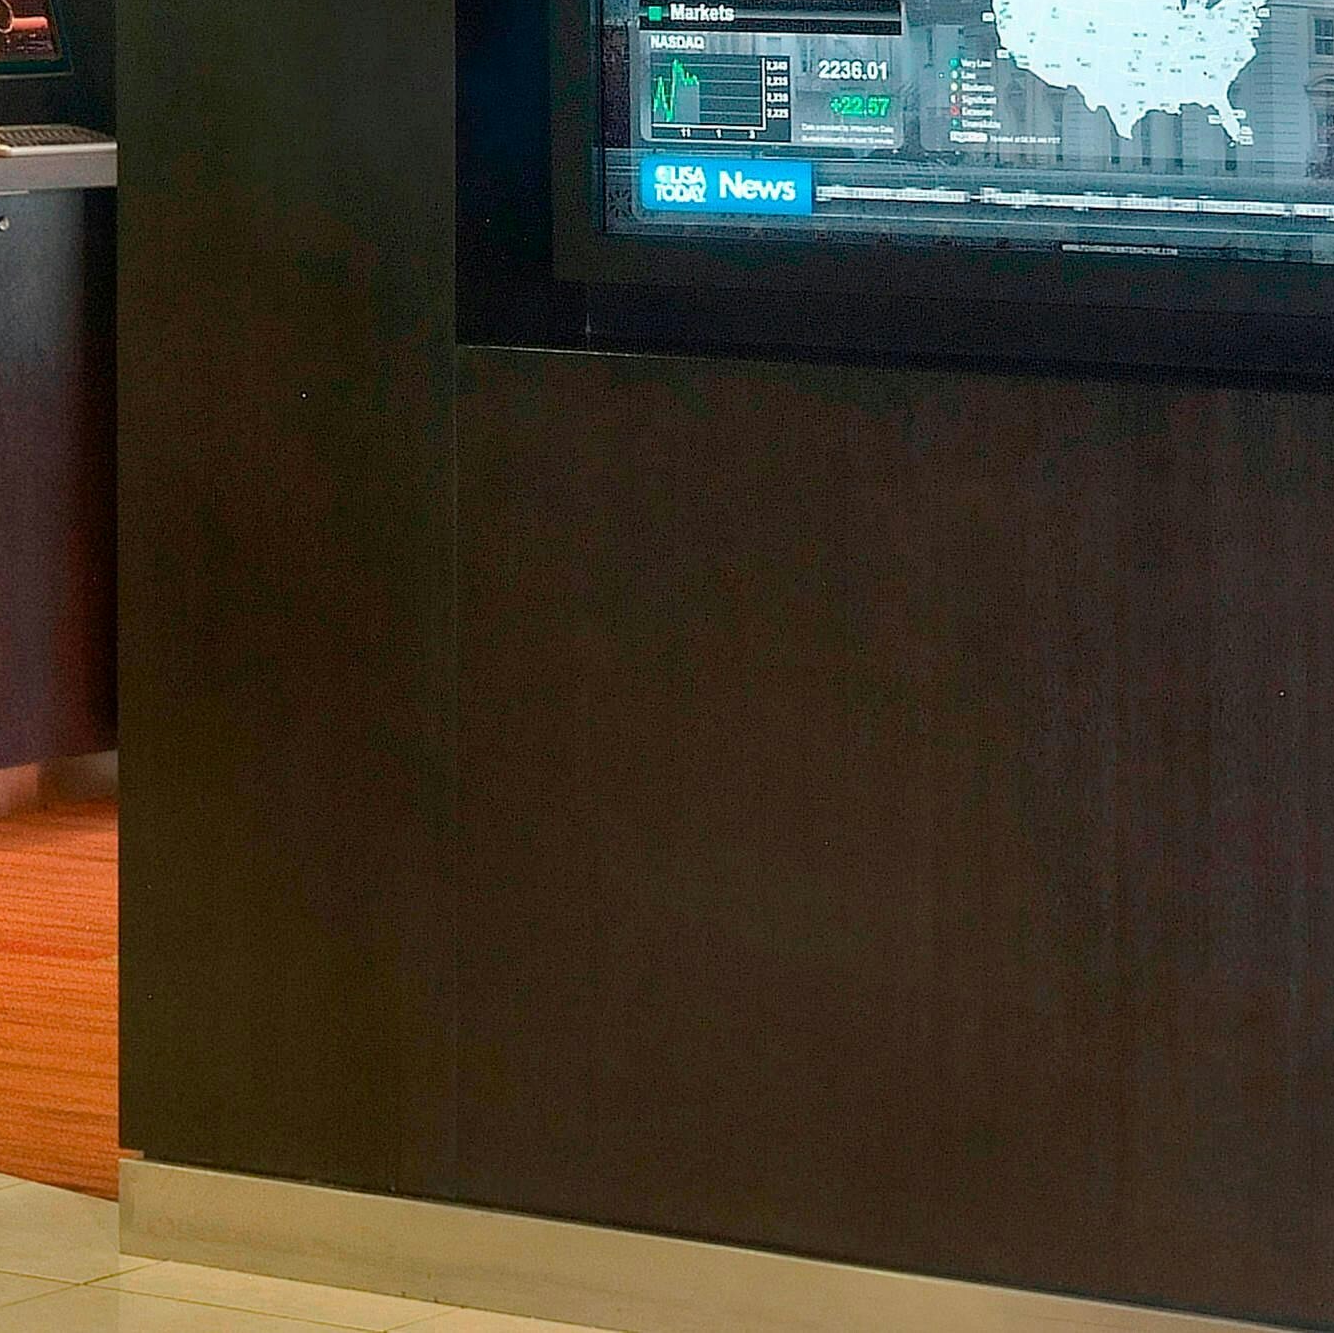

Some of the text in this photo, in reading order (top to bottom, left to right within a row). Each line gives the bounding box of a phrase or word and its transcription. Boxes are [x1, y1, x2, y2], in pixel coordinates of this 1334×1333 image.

[670, 3, 735, 22] Markets
[650, 35, 705, 49] NASDAQ
[818, 59, 888, 80] 2236.01
[830, 96, 890, 117] +22.57
[719, 170, 796, 202] News
